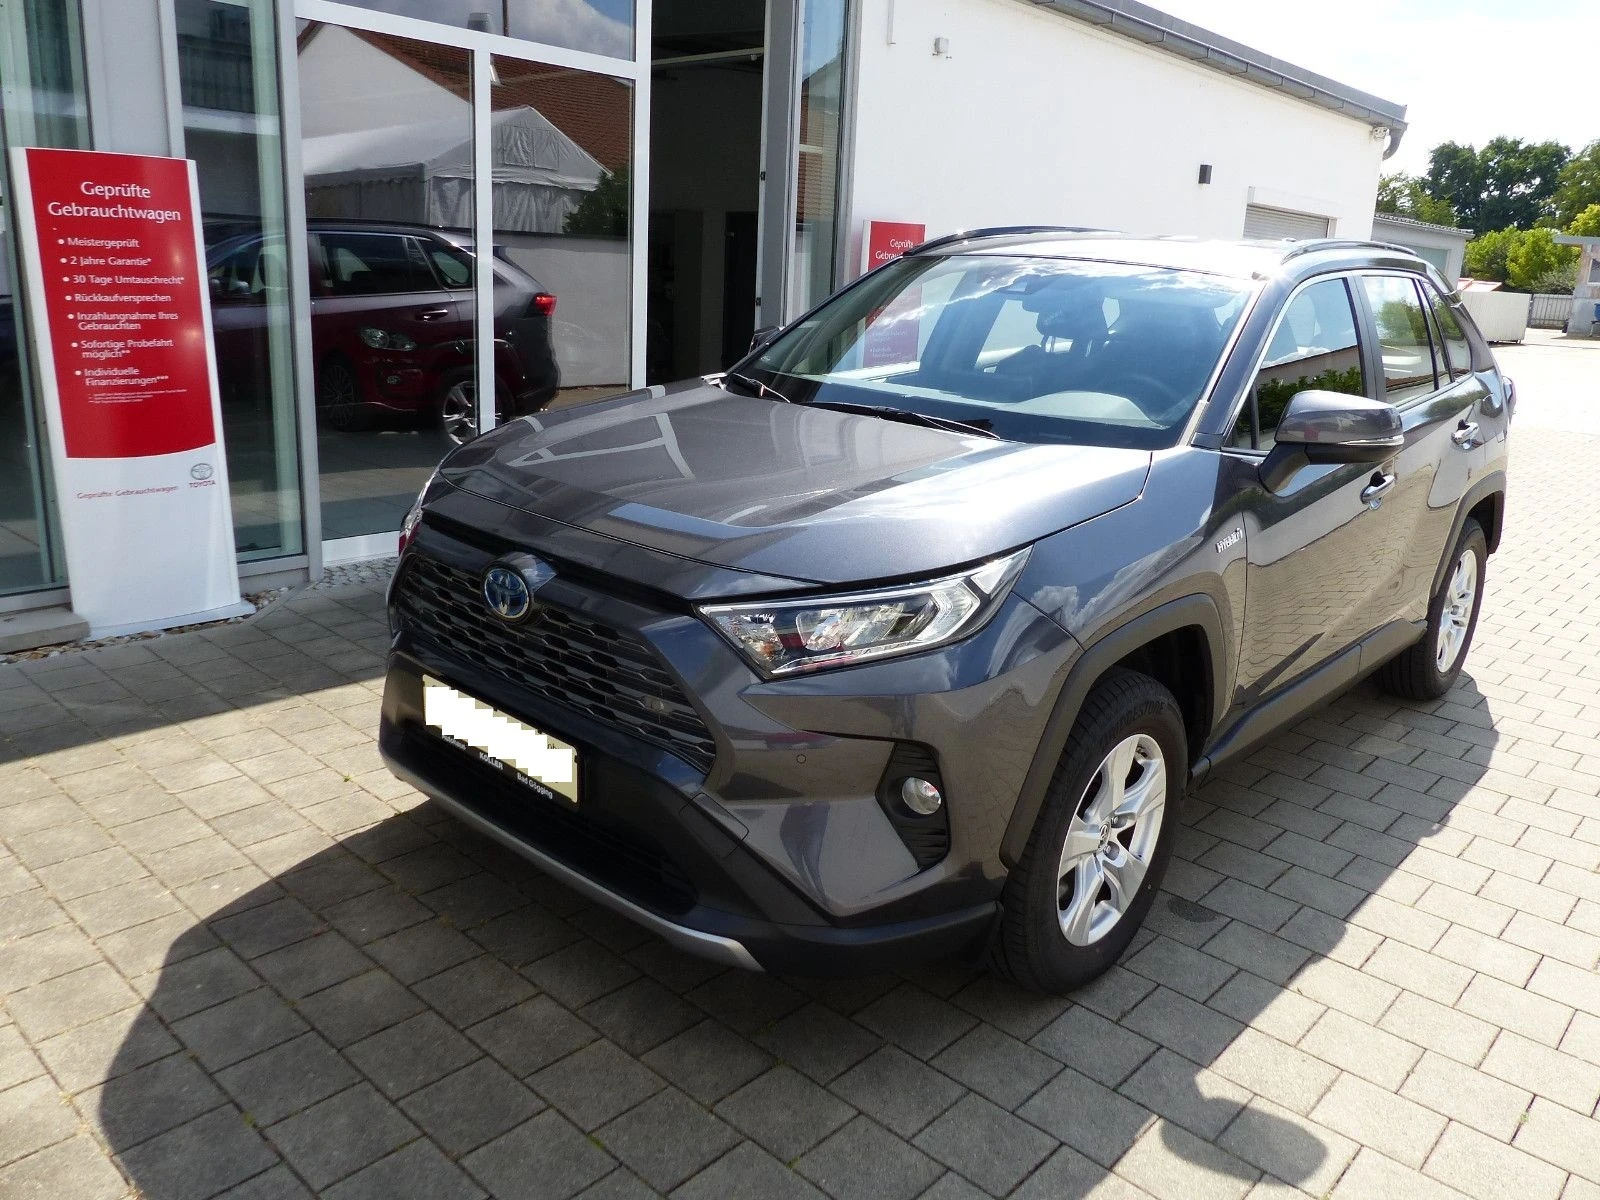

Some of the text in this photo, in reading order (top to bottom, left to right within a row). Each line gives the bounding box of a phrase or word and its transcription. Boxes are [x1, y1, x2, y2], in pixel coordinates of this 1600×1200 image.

[80, 181, 151, 199] Geprüfte
[48, 202, 181, 224] Gebrauchtwagen
[67, 237, 140, 249] Meistergeprüft
[70, 256, 78, 265] 2
[80, 256, 106, 266] Jahre
[72, 275, 87, 284] 30
[89, 275, 113, 286] Tage
[74, 293, 172, 304] Rückkaufversprechen
[77, 312, 179, 323] Inzahlungnahme Ihres
[78, 321, 142, 331] Gebrauchten
[81, 339, 174, 351] Sofortige Probefahrt
[84, 367, 140, 377] Individuelle
[189, 480, 216, 488] TOYOTA
